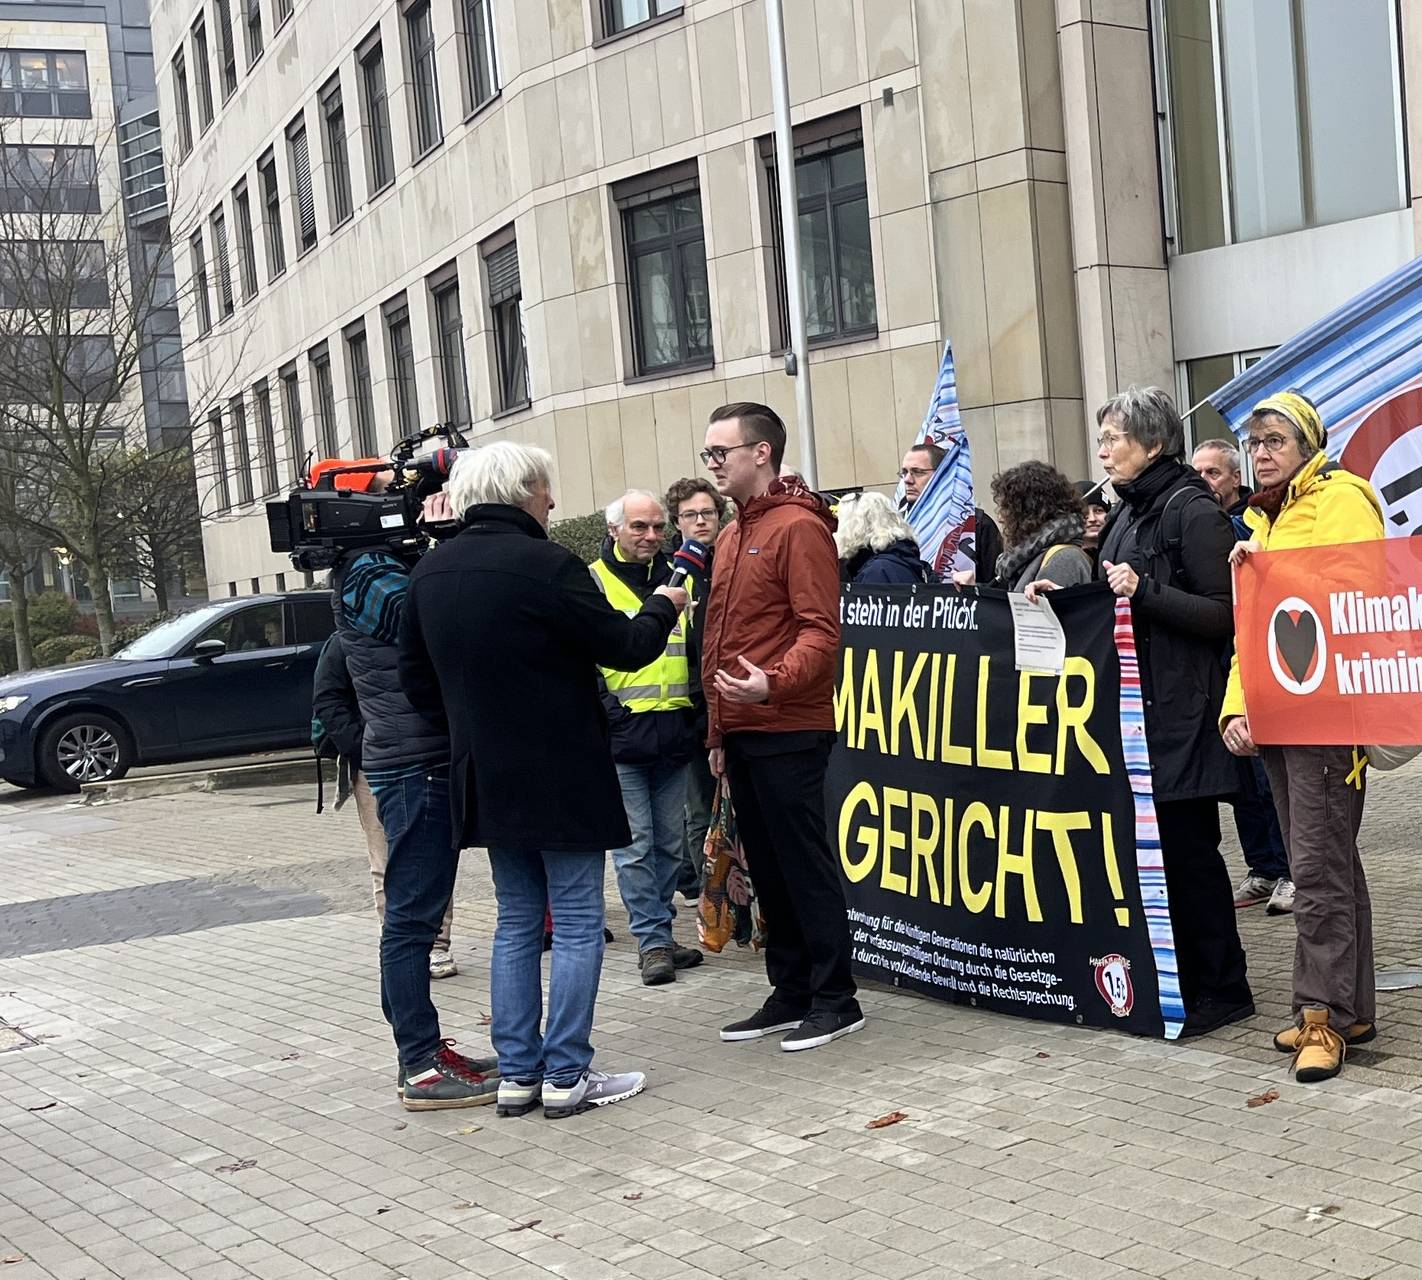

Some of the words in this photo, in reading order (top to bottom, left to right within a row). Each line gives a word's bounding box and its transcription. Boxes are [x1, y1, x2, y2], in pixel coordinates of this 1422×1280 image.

[846, 595, 883, 626] steht
[885, 596, 900, 627] in
[903, 596, 930, 629] der
[838, 781, 1129, 927] GERICHT!
[853, 928, 868, 944] der
[933, 951, 964, 976] Ordnung
[965, 960, 993, 977] durch
[994, 965, 1007, 981] die
[1009, 966, 1062, 989] Gesetzge-
[881, 915, 894, 931] für
[931, 930, 978, 956] Generationen
[980, 943, 993, 959] die
[994, 947, 1055, 964] natürlichen
[957, 979, 977, 993] und
[978, 981, 991, 996] die
[992, 983, 1077, 1011] Rechtsprechung.
